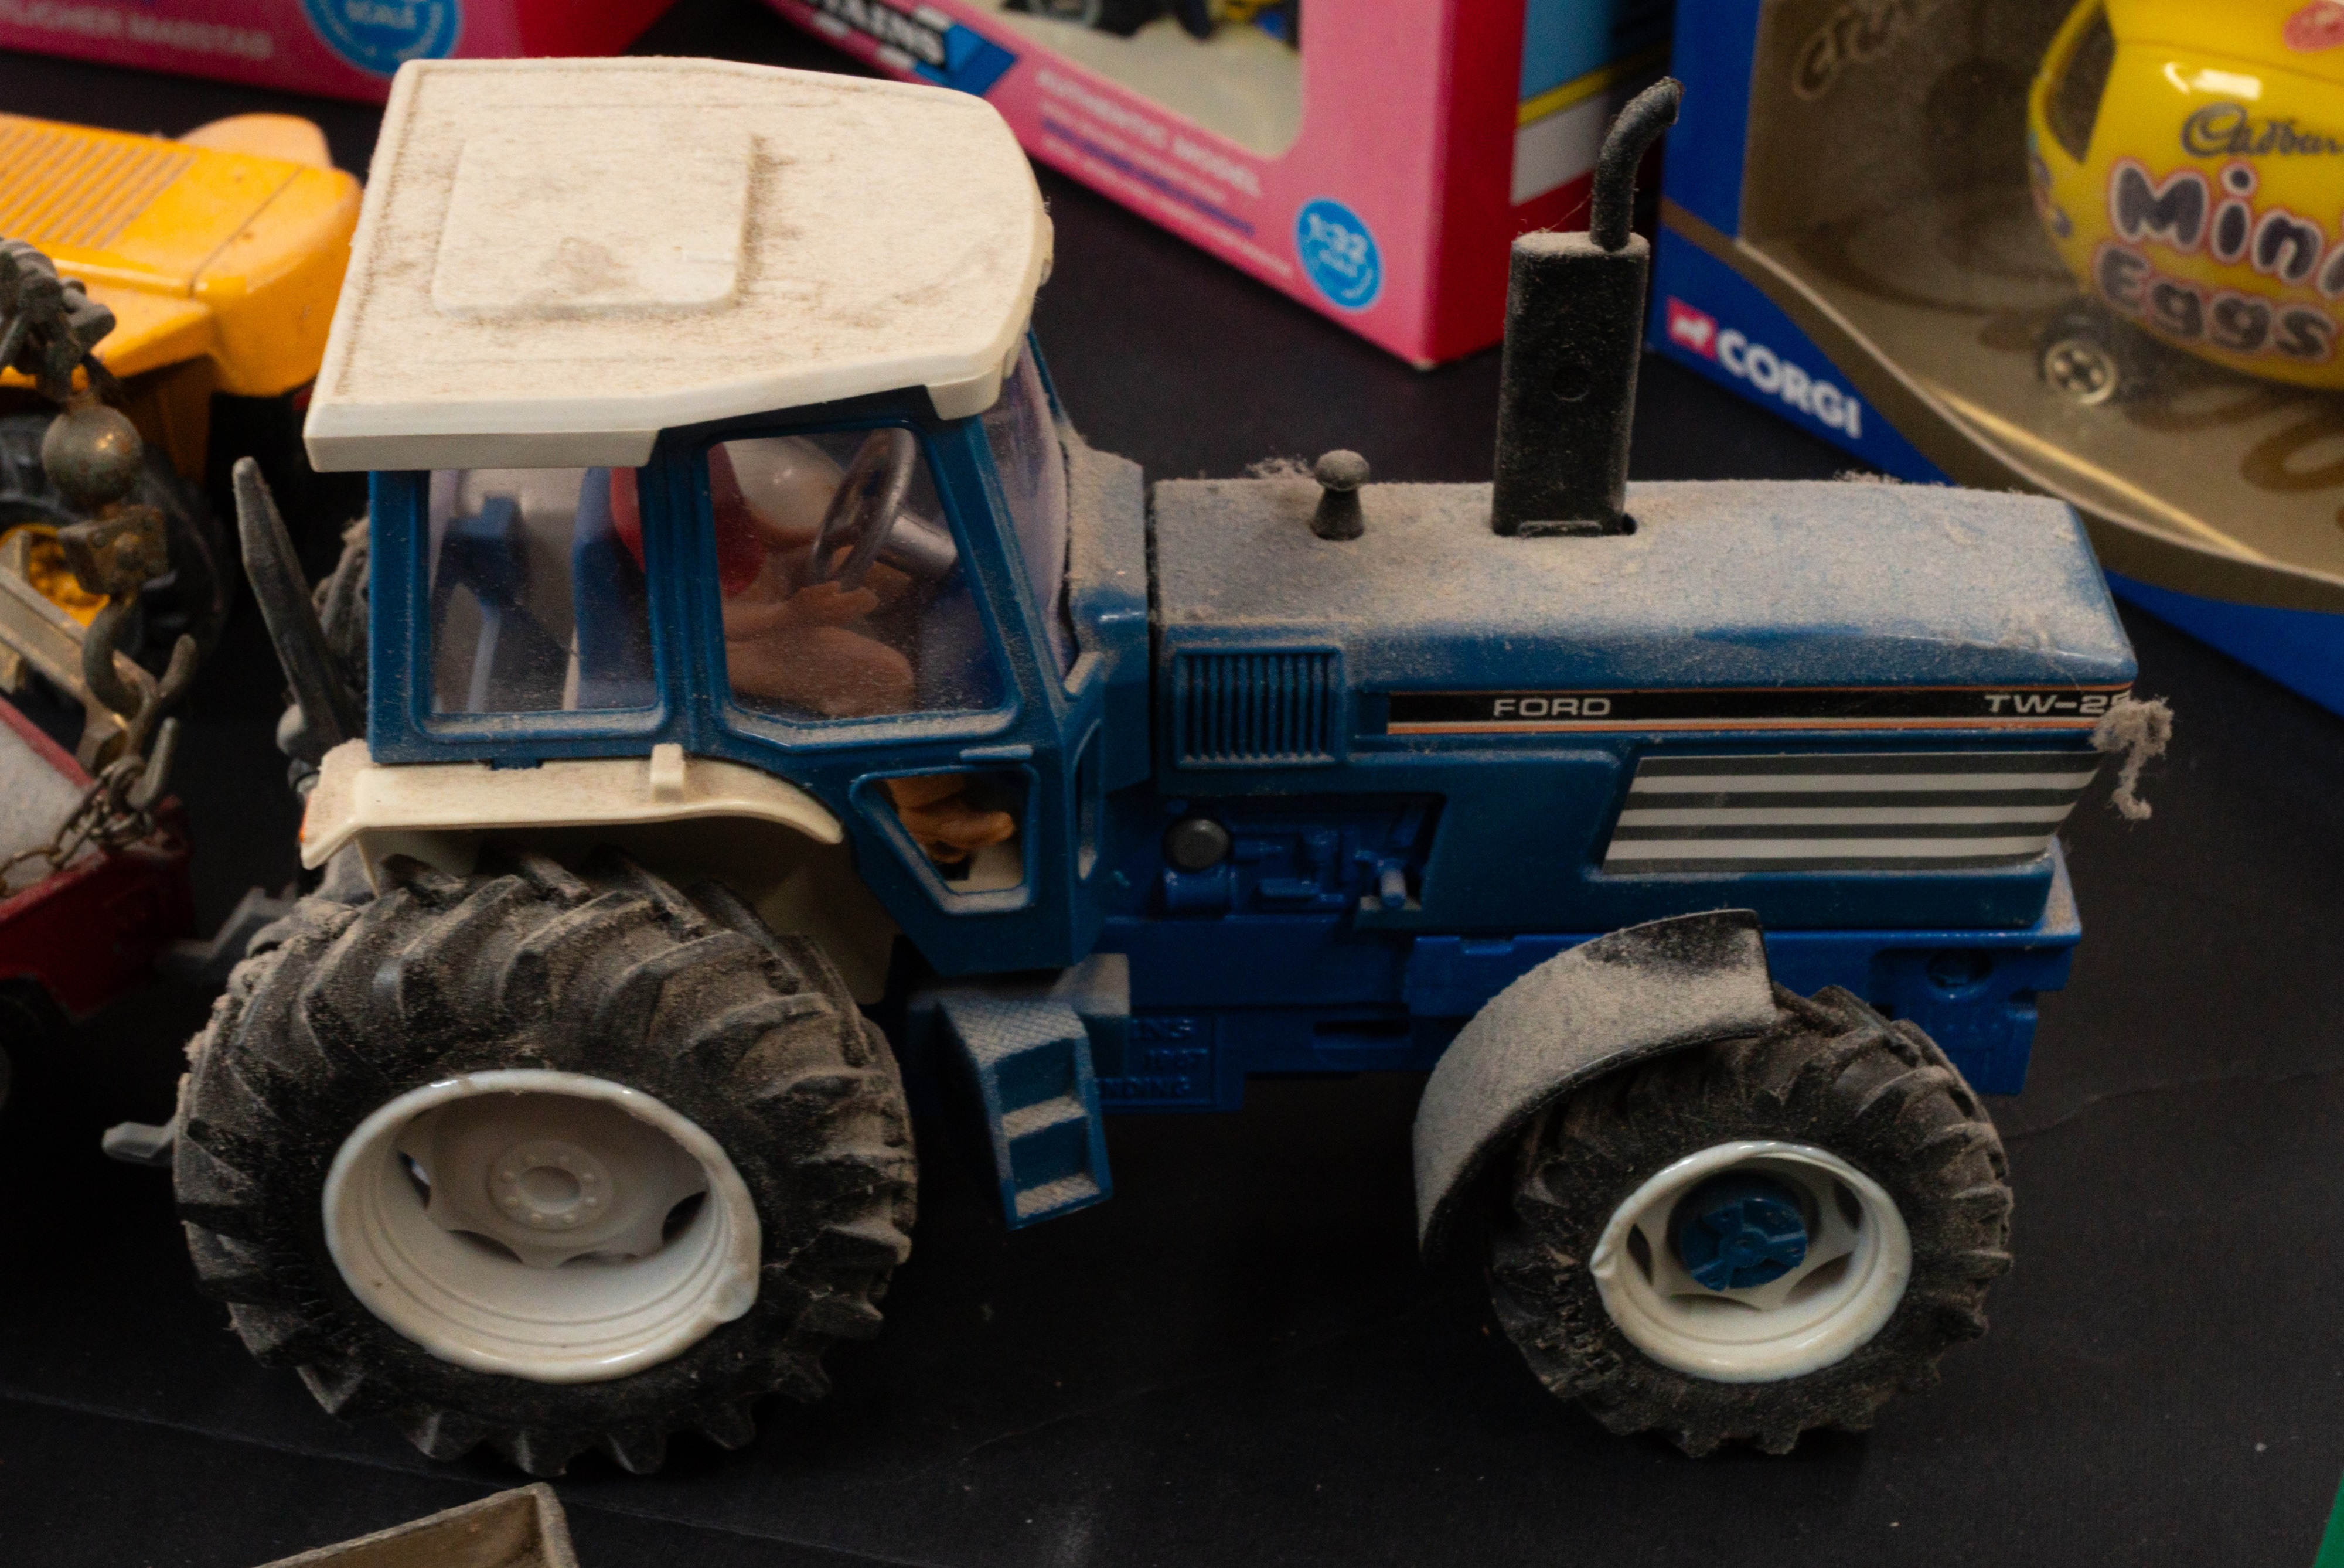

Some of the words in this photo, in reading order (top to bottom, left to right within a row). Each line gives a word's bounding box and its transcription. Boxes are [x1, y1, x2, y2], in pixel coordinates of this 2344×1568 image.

[2180, 101, 2344, 158] Cadbur
[2096, 246, 2335, 360] Eggs
[1716, 327, 1862, 439] CORGI
[1493, 697, 1612, 717] FORD
